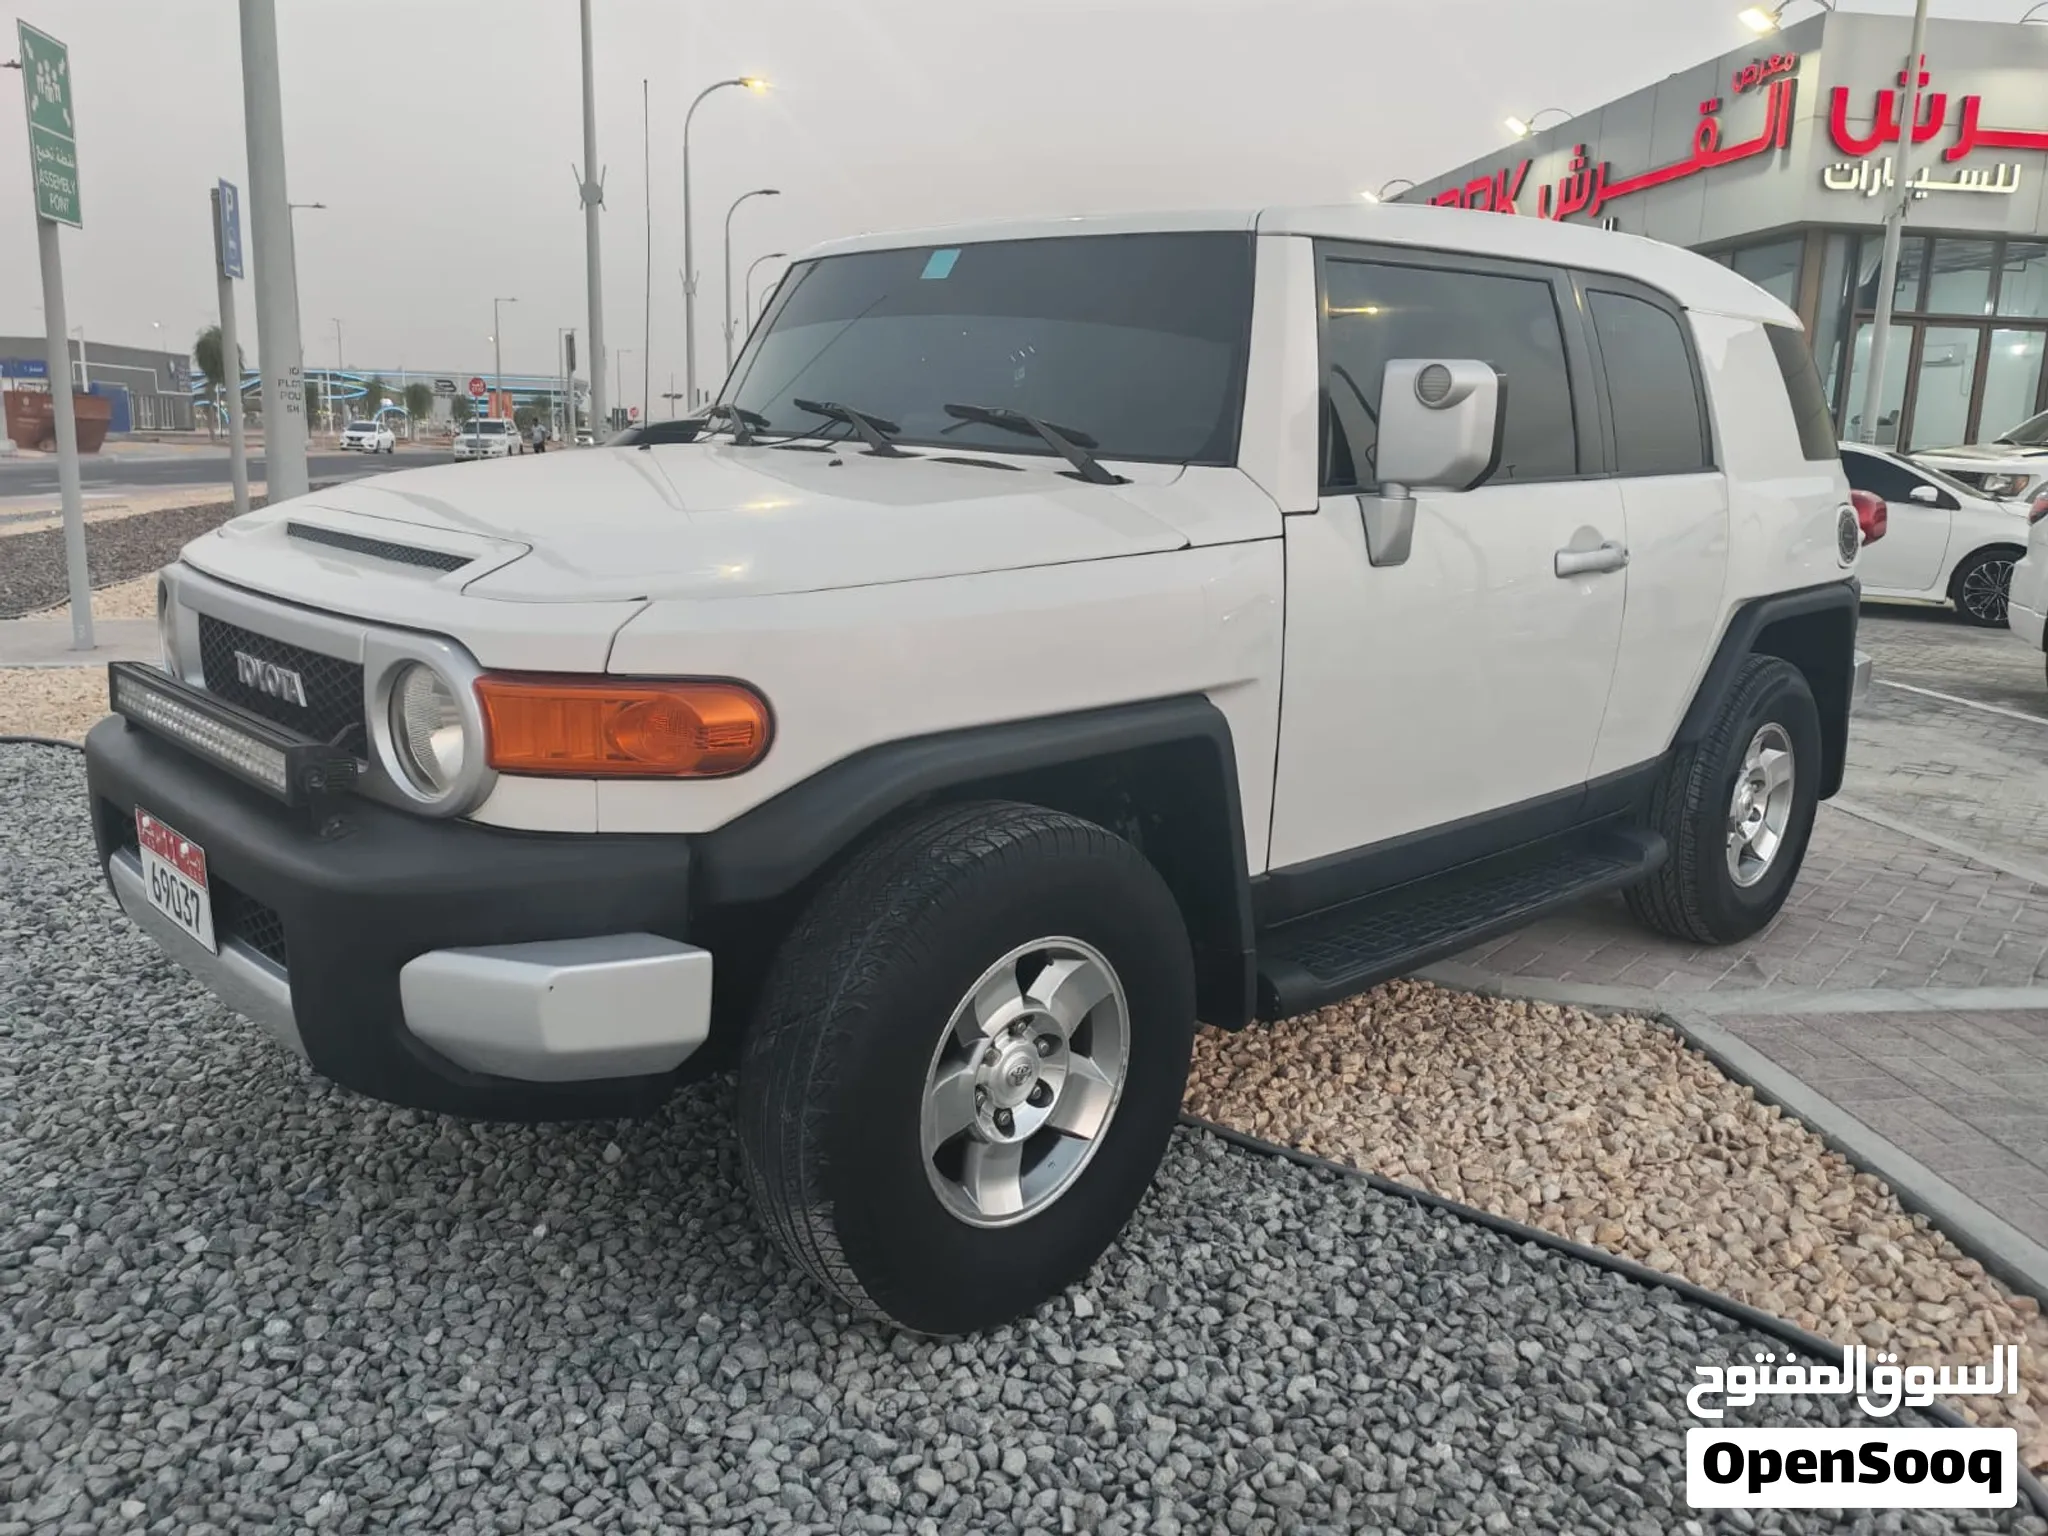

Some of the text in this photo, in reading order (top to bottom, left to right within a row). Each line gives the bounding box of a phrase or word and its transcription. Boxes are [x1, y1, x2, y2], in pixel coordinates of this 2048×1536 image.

[1732, 52, 1796, 93] معرض
[39, 168, 76, 196] ASSEMBLY
[1823, 157, 2021, 198] للسيارات
[49, 188, 70, 213] POINT
[234, 650, 309, 708] TOYOTA
[151, 860, 201, 935] 69037
